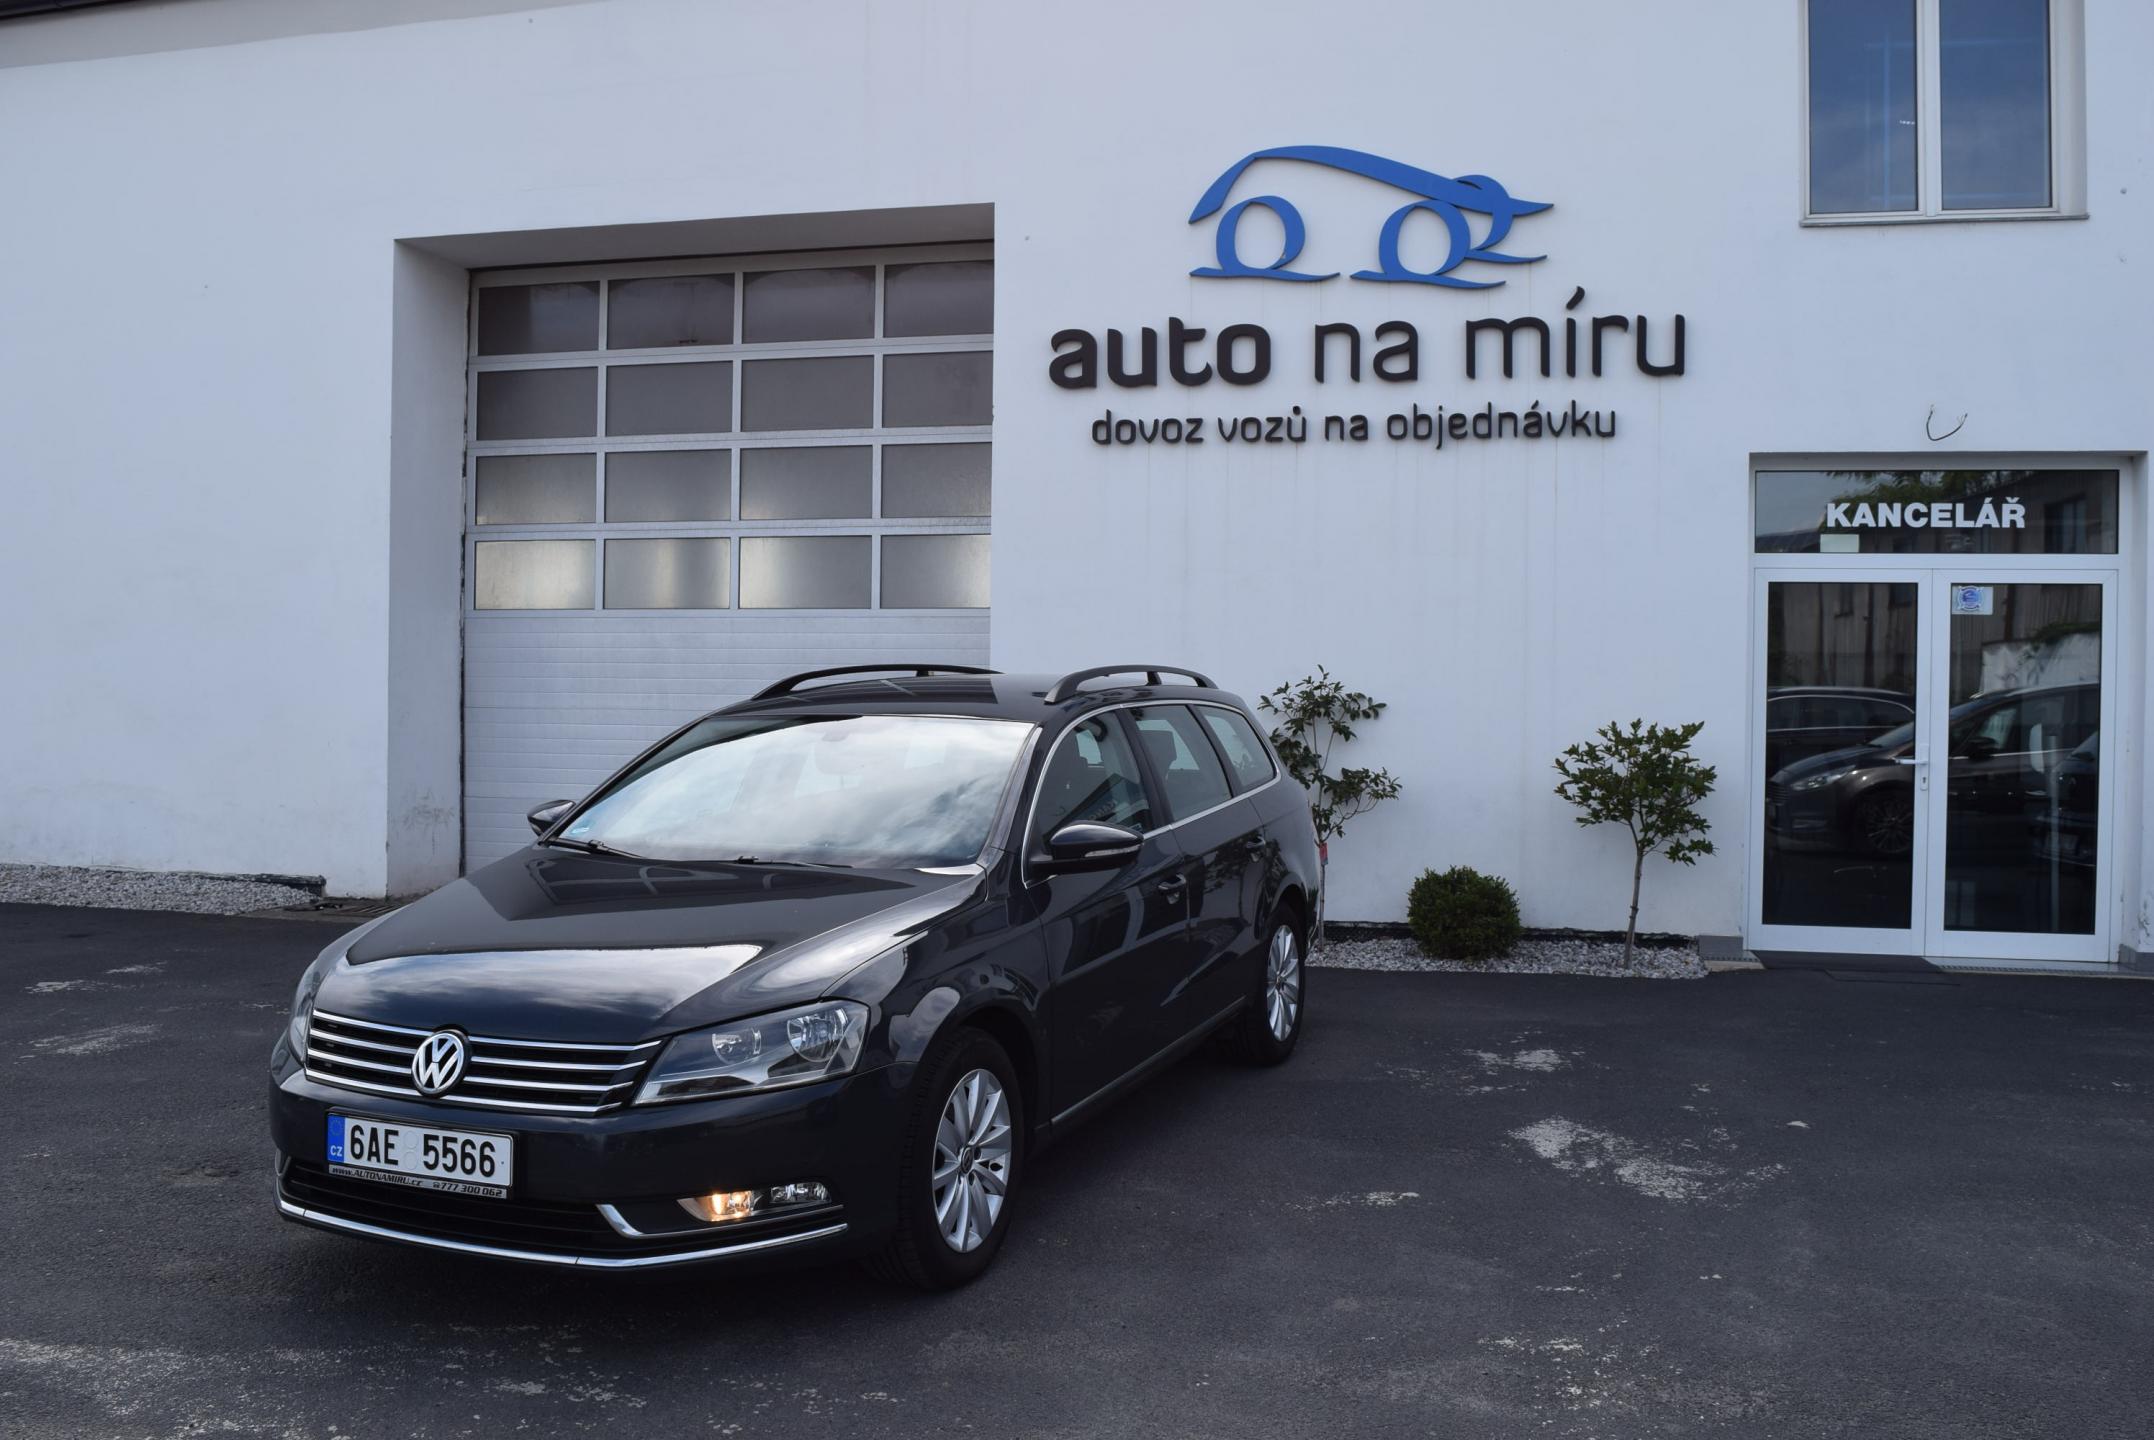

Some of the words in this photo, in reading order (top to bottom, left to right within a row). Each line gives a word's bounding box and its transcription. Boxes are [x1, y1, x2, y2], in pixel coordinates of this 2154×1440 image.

[1049, 316, 1272, 389] auto
[1314, 319, 1420, 384] na
[1465, 285, 1686, 379] míru
[1092, 408, 1205, 446] dovoz
[1217, 404, 1307, 444] vozů
[1324, 408, 1370, 441] na
[1386, 400, 1617, 450] objednávku
[1827, 497, 2025, 528] KANCELÁŘ
[330, 1145, 343, 1157] CZ
[351, 1125, 399, 1165] 6AE
[423, 1134, 495, 1177] 5566
[460, 1184, 481, 1195] 300
[482, 1187, 503, 1198] 062
